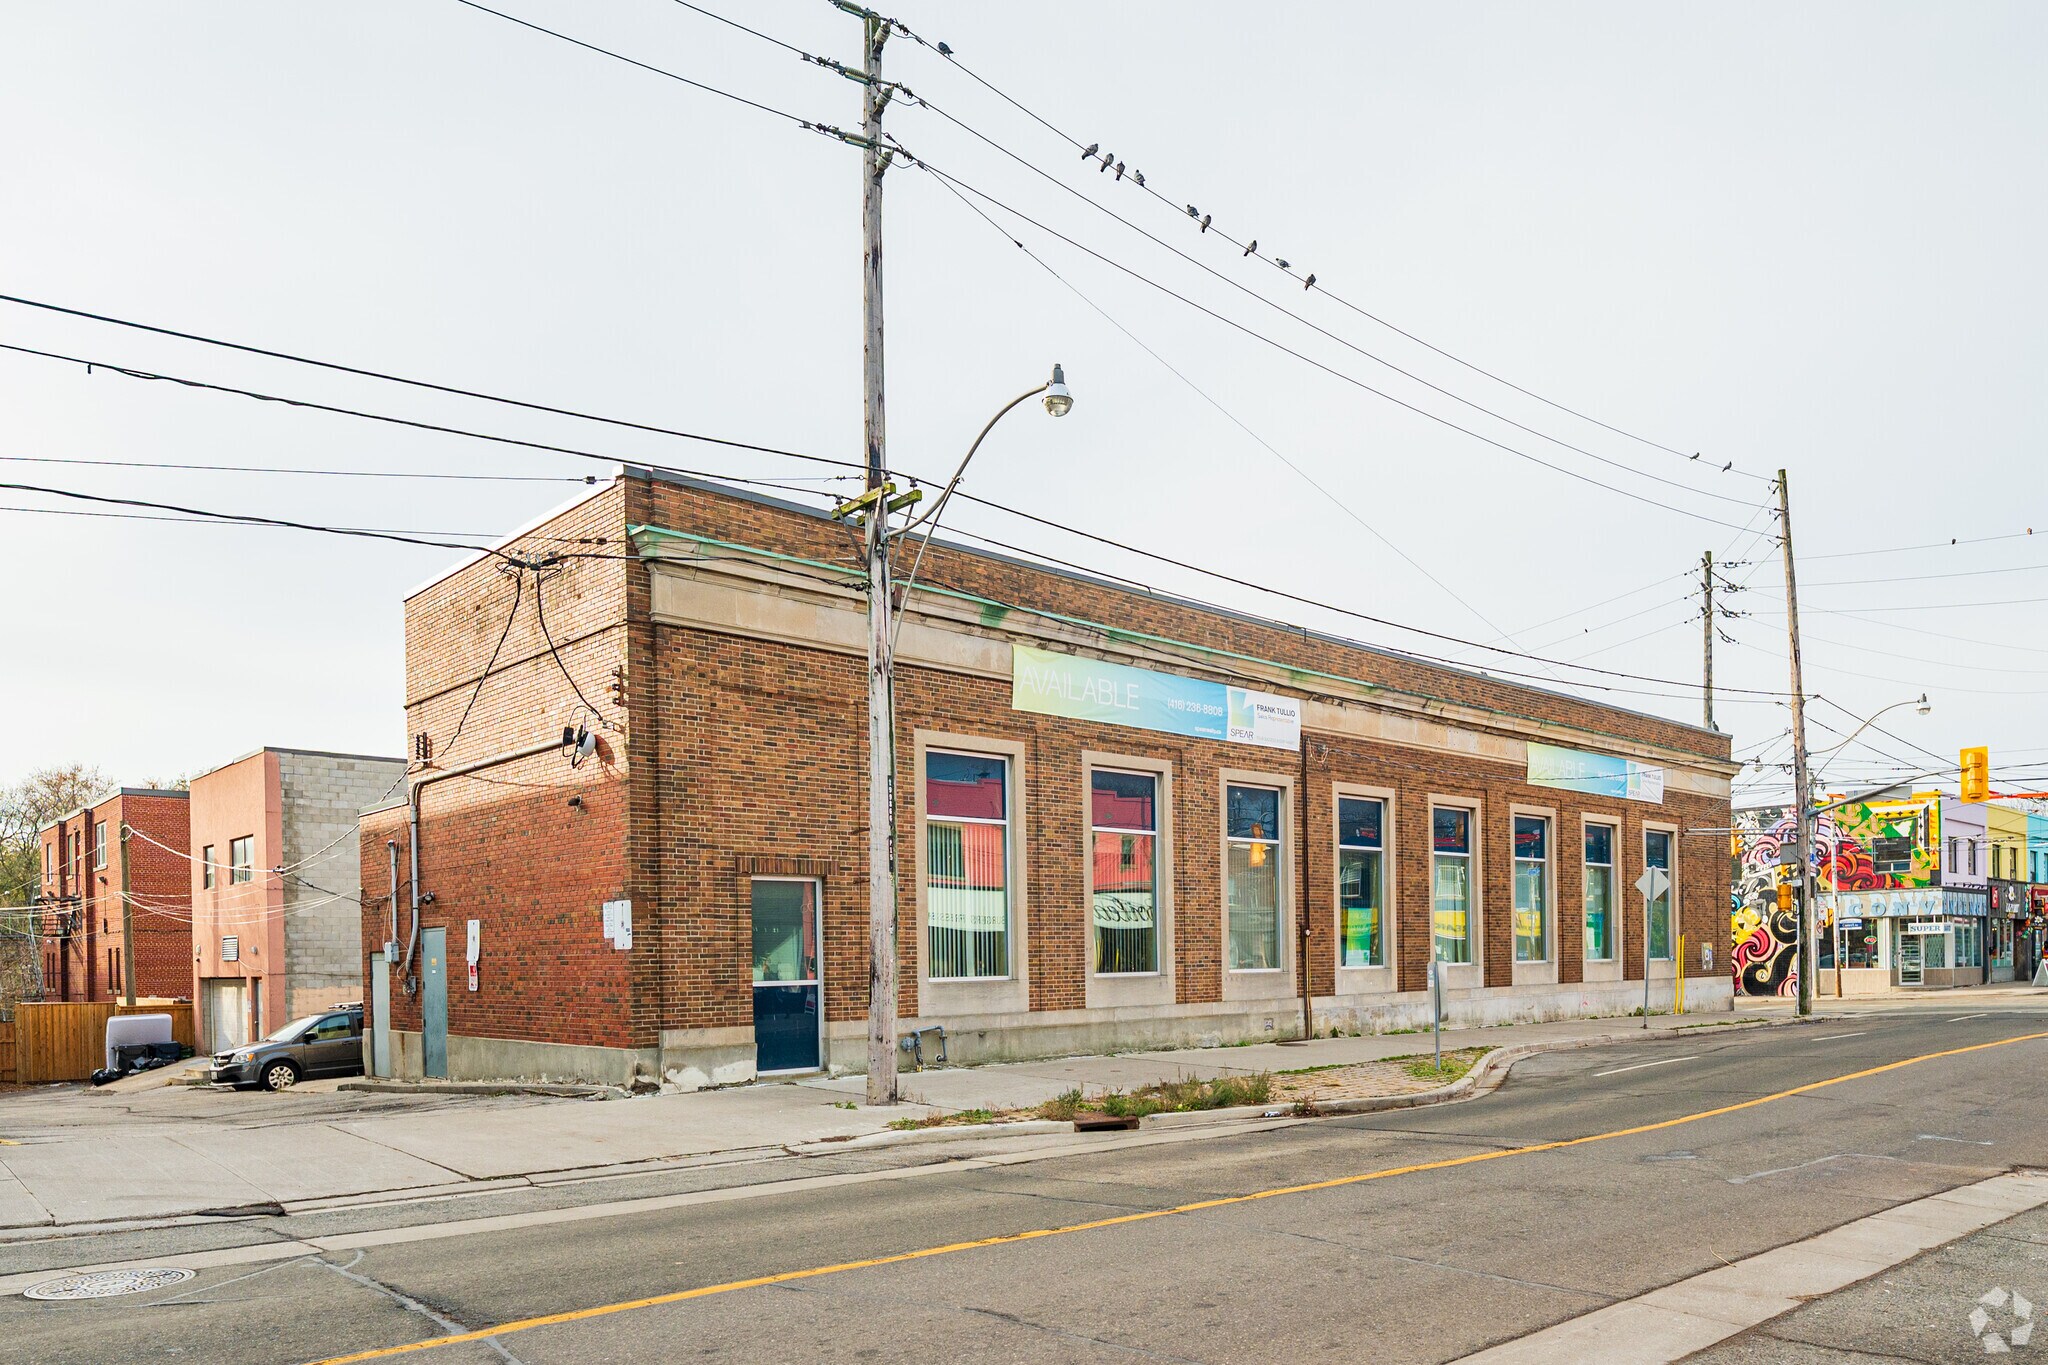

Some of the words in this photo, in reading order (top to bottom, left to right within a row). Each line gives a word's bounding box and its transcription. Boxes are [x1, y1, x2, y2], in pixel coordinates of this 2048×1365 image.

[1018, 665, 1140, 710] AVAILABLE
[1256, 704, 1277, 714] FRANK
[1230, 728, 1254, 740] SPEAR
[1530, 754, 1585, 778] AVAILABLE
